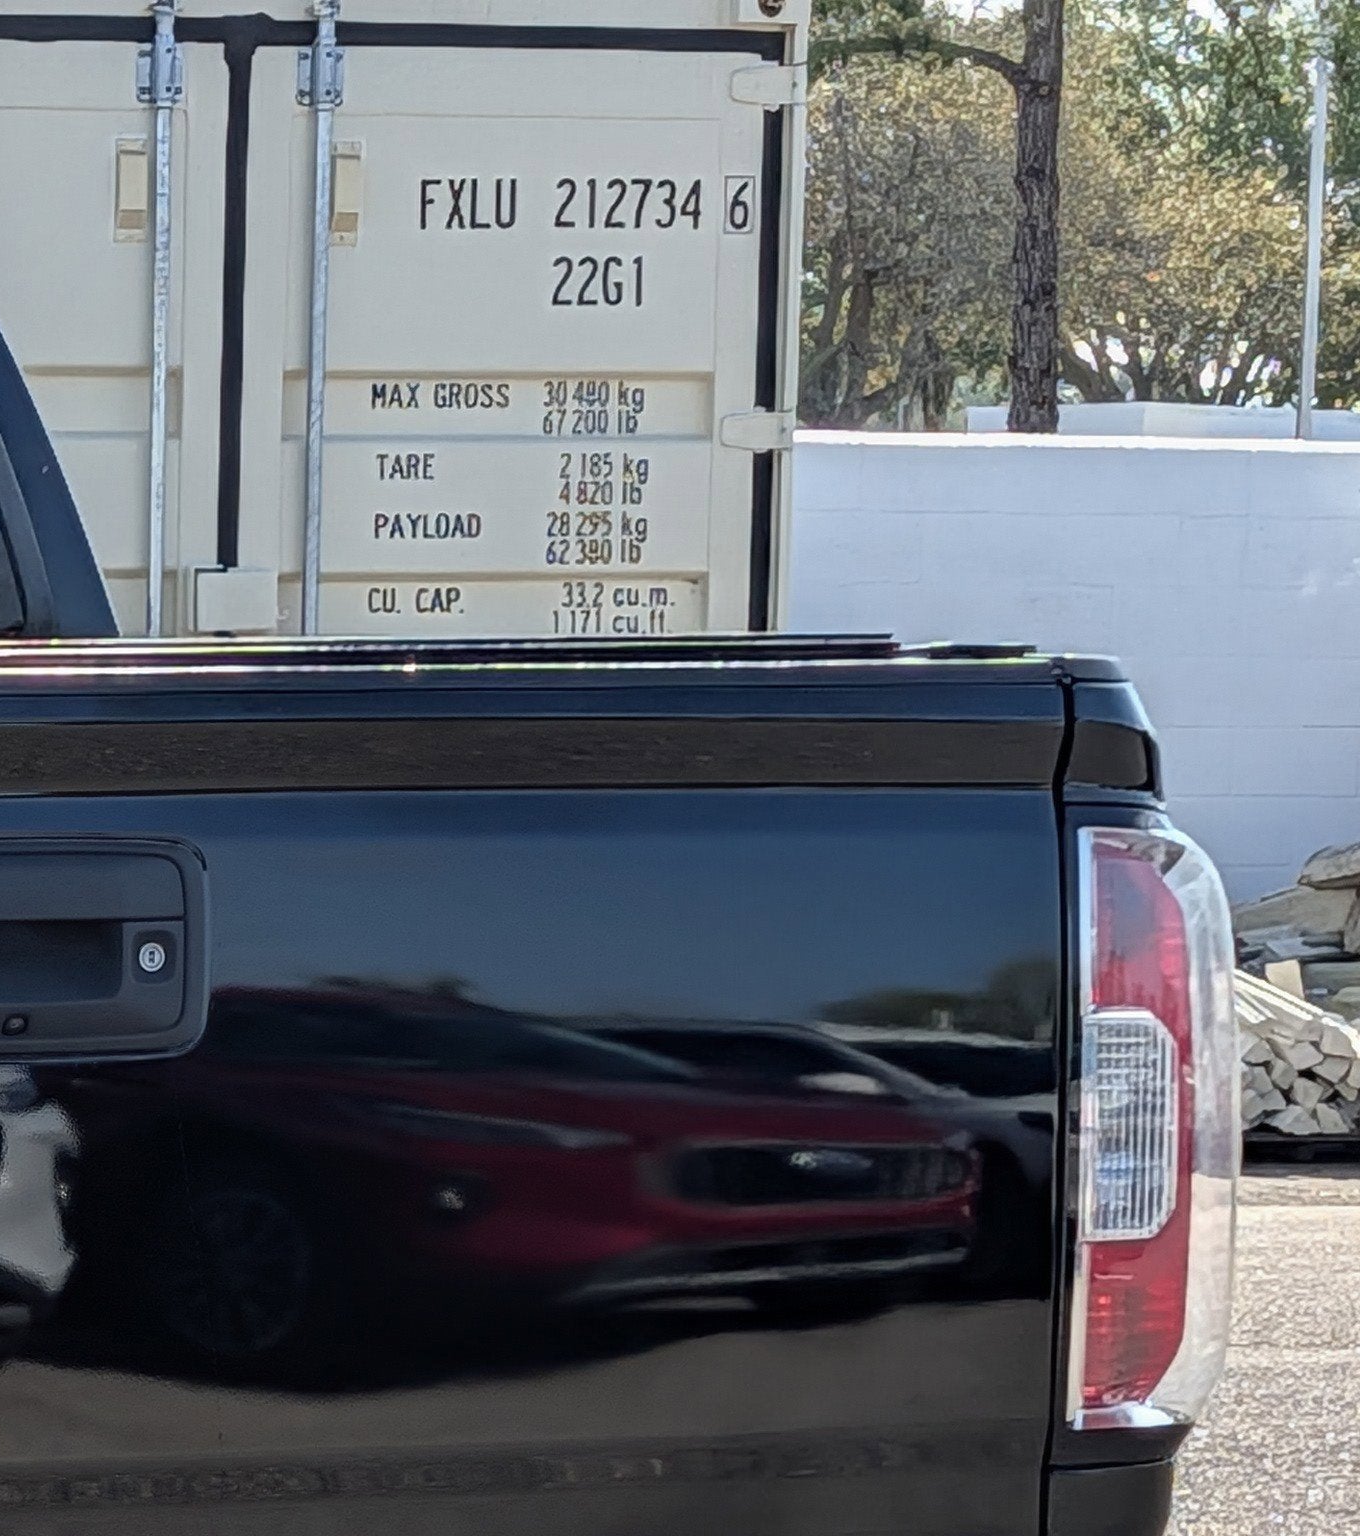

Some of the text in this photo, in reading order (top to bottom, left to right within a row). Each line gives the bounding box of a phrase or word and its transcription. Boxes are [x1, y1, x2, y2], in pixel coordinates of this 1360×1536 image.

[420, 178, 750, 230] FXLU 212734 6
[551, 256, 645, 307] 22G1
[371, 382, 420, 409] MAX
[433, 382, 510, 409] GROSS
[617, 382, 645, 415] kg
[542, 410, 639, 436] 67 200 lb
[376, 453, 435, 480] TARE
[579, 452, 613, 479] 185
[622, 453, 649, 484] kg
[577, 481, 613, 505] 820
[622, 481, 642, 505] lb
[374, 513, 482, 539] PAYLOAD
[546, 512, 570, 538] 28
[621, 512, 648, 542] kg
[546, 539, 570, 565] 62
[621, 540, 641, 565] lb
[368, 587, 401, 614] CU.
[416, 587, 465, 615] CAP.
[561, 582, 604, 609] 33.2
